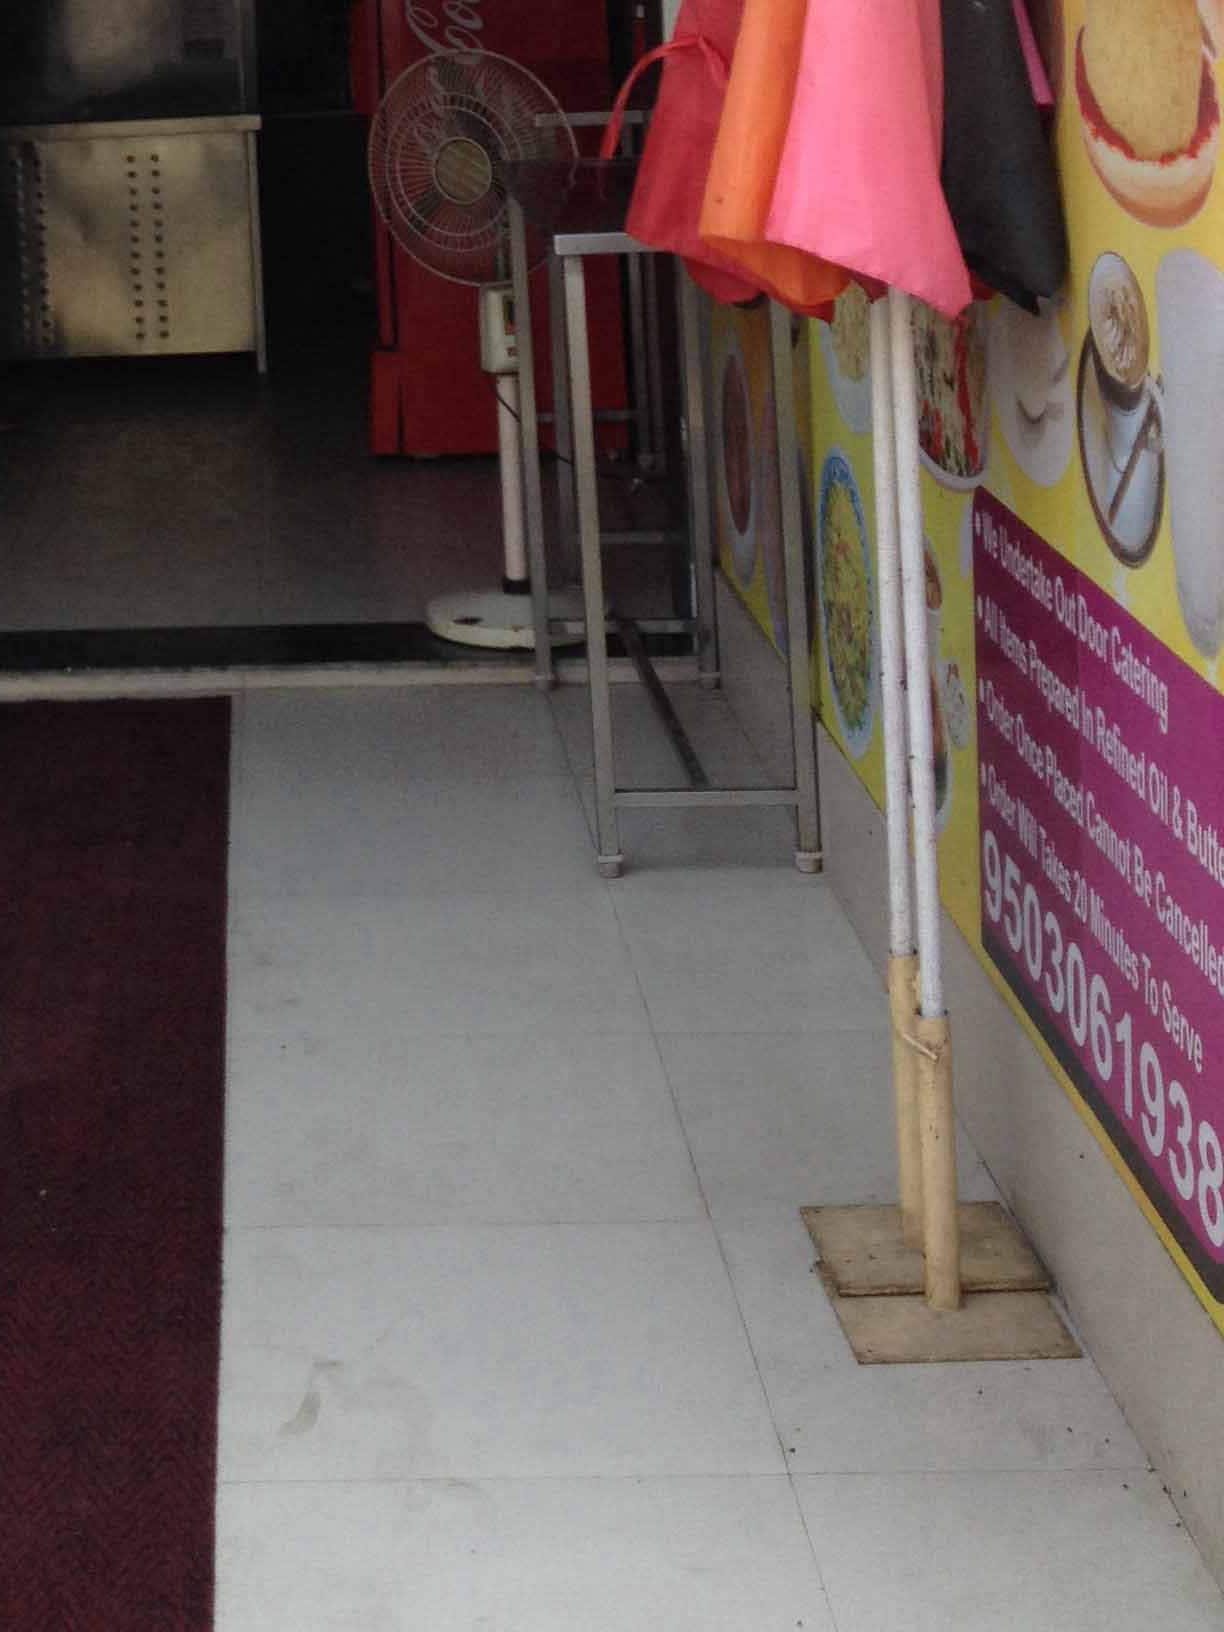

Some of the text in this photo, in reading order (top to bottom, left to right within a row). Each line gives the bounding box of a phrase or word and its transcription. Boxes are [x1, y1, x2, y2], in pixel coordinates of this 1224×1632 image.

[1029, 640, 1080, 729] Prepared
[1096, 706, 1145, 800] Refined
[1148, 762, 1168, 826] Oil
[1173, 785, 1184, 841] &
[1111, 626, 1169, 735] Catering
[1016, 714, 1044, 780] Once
[1044, 744, 1084, 826] Placed
[1086, 791, 1131, 884] Cannot
[1134, 844, 1153, 908] Be
[982, 829, 1224, 1249] 9503061938
[1039, 825, 1072, 903] Takes
[1074, 870, 1088, 924] 20
[1090, 887, 1140, 991] Minutes
[1142, 952, 1159, 1017] To
[1161, 979, 1204, 1074] Serve
